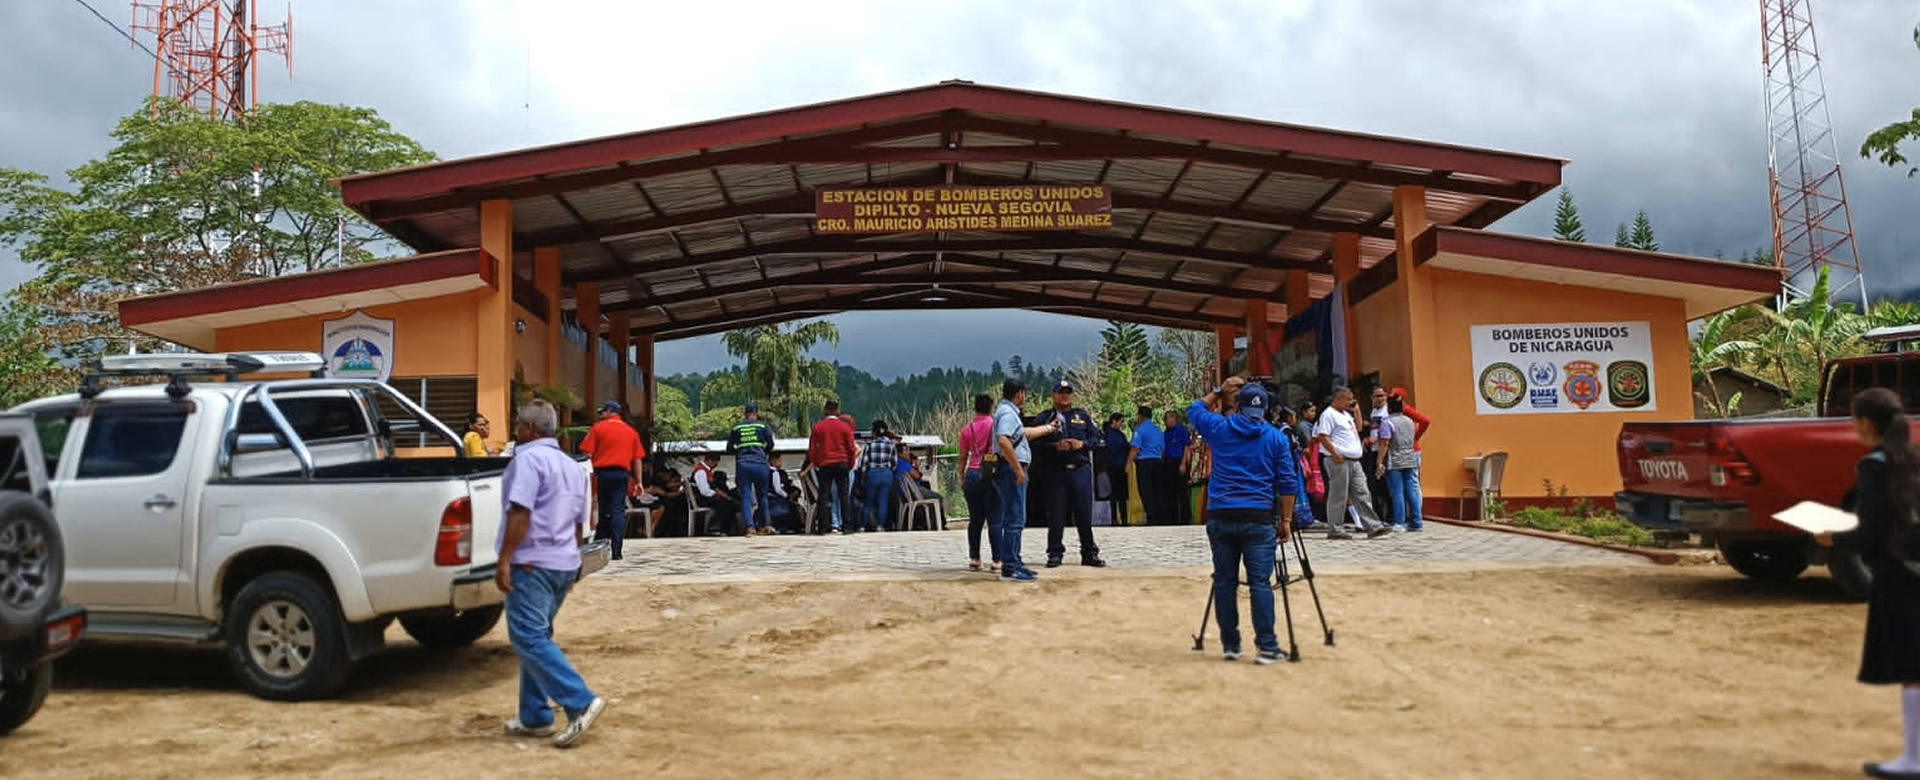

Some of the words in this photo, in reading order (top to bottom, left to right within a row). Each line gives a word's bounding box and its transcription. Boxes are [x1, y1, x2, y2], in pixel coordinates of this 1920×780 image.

[823, 190, 908, 203] ESTACION
[913, 190, 935, 201] DE
[940, 188, 1034, 202] BOMBEROS
[1039, 186, 1104, 200] UNIDOS
[854, 204, 921, 216] DIPILTO
[936, 203, 994, 215] NUEVA
[999, 201, 1073, 214] SEGOVIA
[818, 219, 850, 231] CRO.
[854, 218, 922, 231] MAURICIO
[926, 216, 997, 230] ARISTIDES
[1001, 215, 1054, 228] MEDINA
[1058, 213, 1112, 227] SUAREZ
[1493, 328, 1571, 340] BOMBEROS
[1574, 327, 1629, 339] UNIDOS
[1509, 342, 1528, 353] DE
[1531, 340, 1614, 353] NICARAGUA
[1638, 459, 1689, 481] TOYOTA
